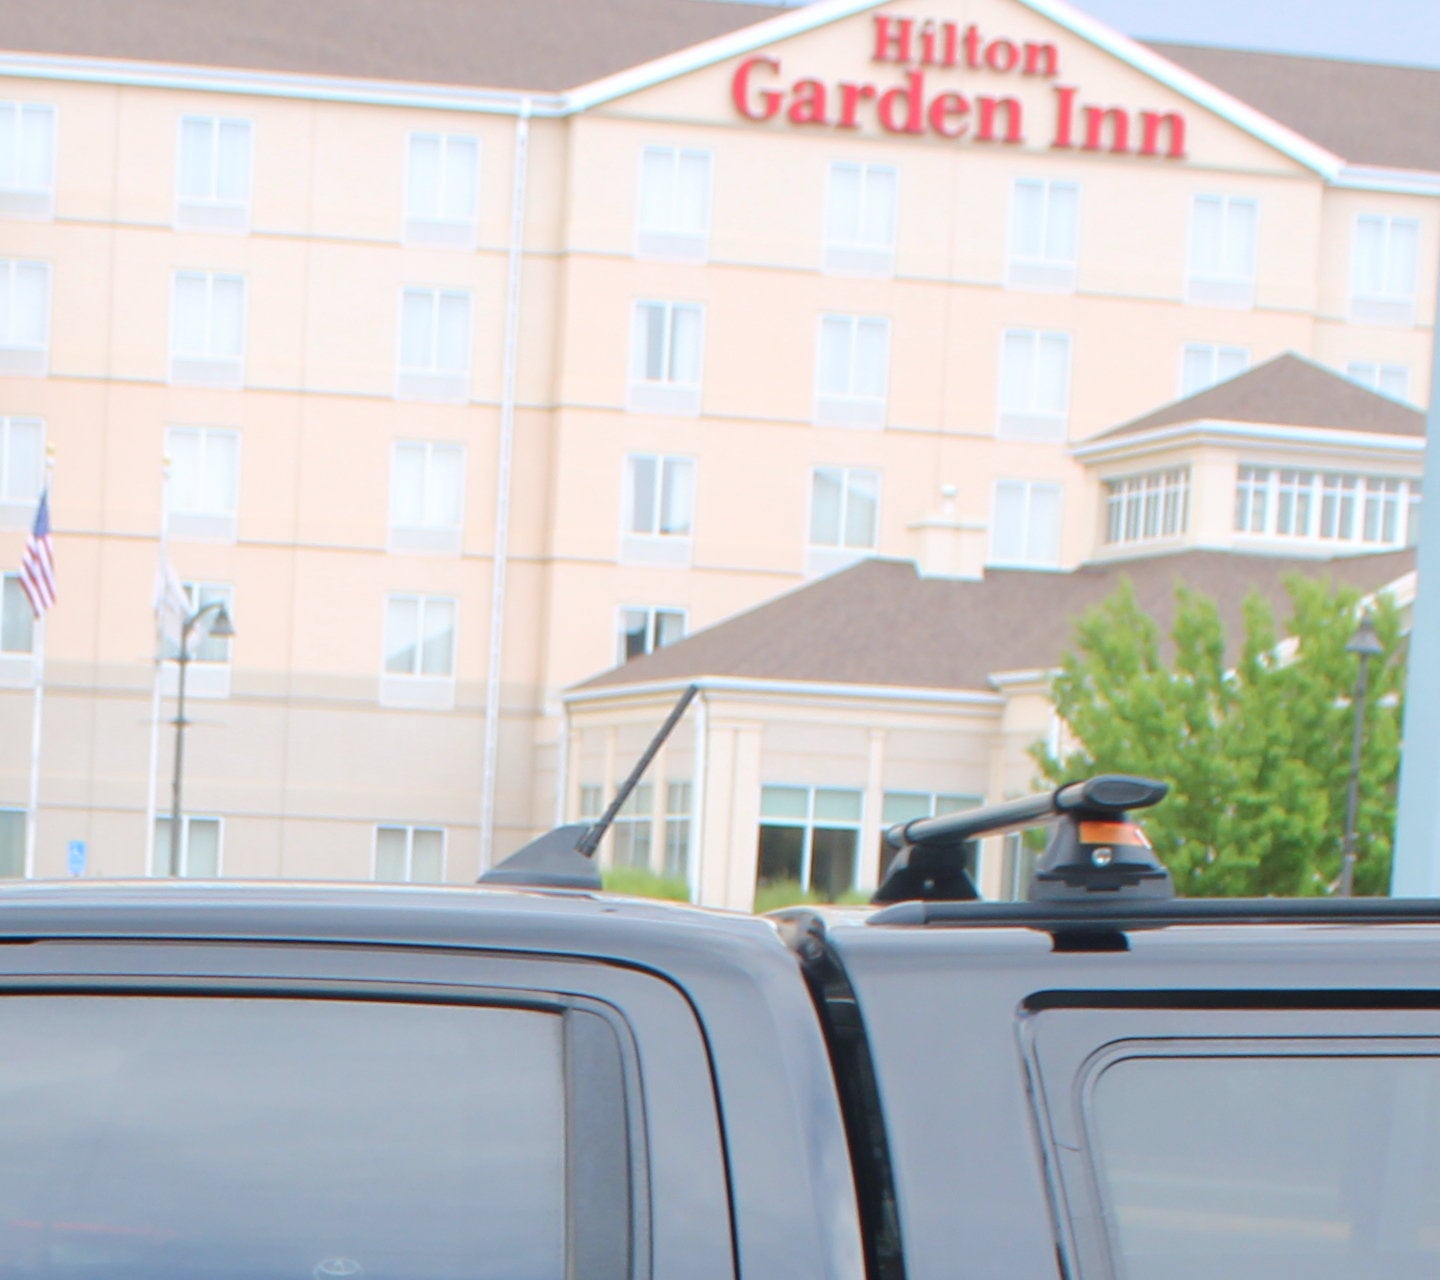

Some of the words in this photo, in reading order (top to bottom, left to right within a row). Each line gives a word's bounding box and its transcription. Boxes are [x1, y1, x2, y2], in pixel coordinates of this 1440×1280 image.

[872, 14, 1059, 77] Hilton
[731, 54, 1024, 145] Garden
[1051, 84, 1188, 158] Inn
